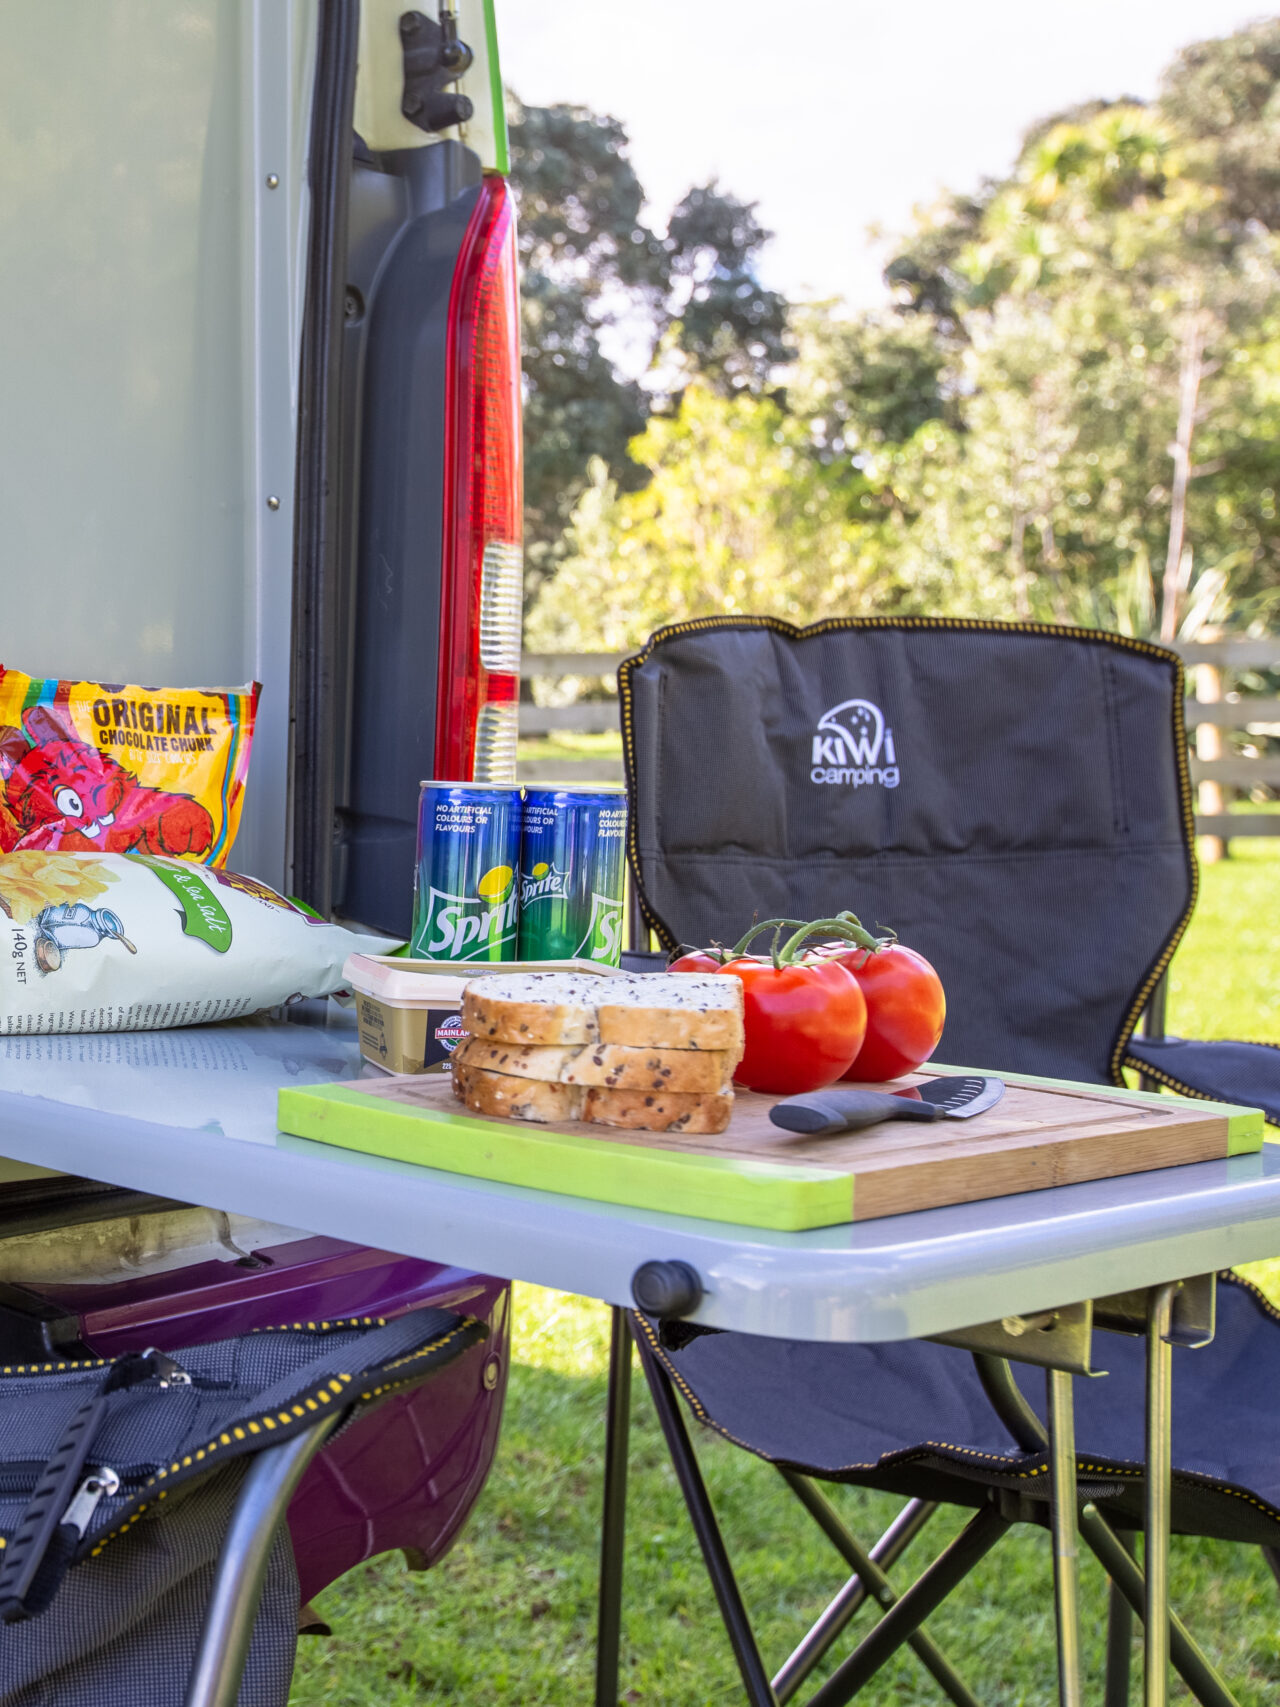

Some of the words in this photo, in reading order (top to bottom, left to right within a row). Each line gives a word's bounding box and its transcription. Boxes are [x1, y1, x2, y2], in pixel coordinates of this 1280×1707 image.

[93, 699, 217, 736] ORIGINAL
[99, 729, 168, 752] CHOCOLATE
[170, 737, 215, 752] CHUNK
[810, 764, 901, 789] camping
[436, 805, 448, 813] NO
[449, 805, 493, 815] ARTIFICIAL
[599, 809, 611, 818] NO
[435, 814, 474, 824] COLOURS
[475, 816, 488, 825] OR
[542, 817, 555, 825] OR
[435, 824, 476, 833] FLAVOURS
[522, 873, 562, 901] Sprite
[11, 928, 28, 959] 140g
[16, 961, 27, 985] NET
[437, 1029, 470, 1037] MAINLAN
